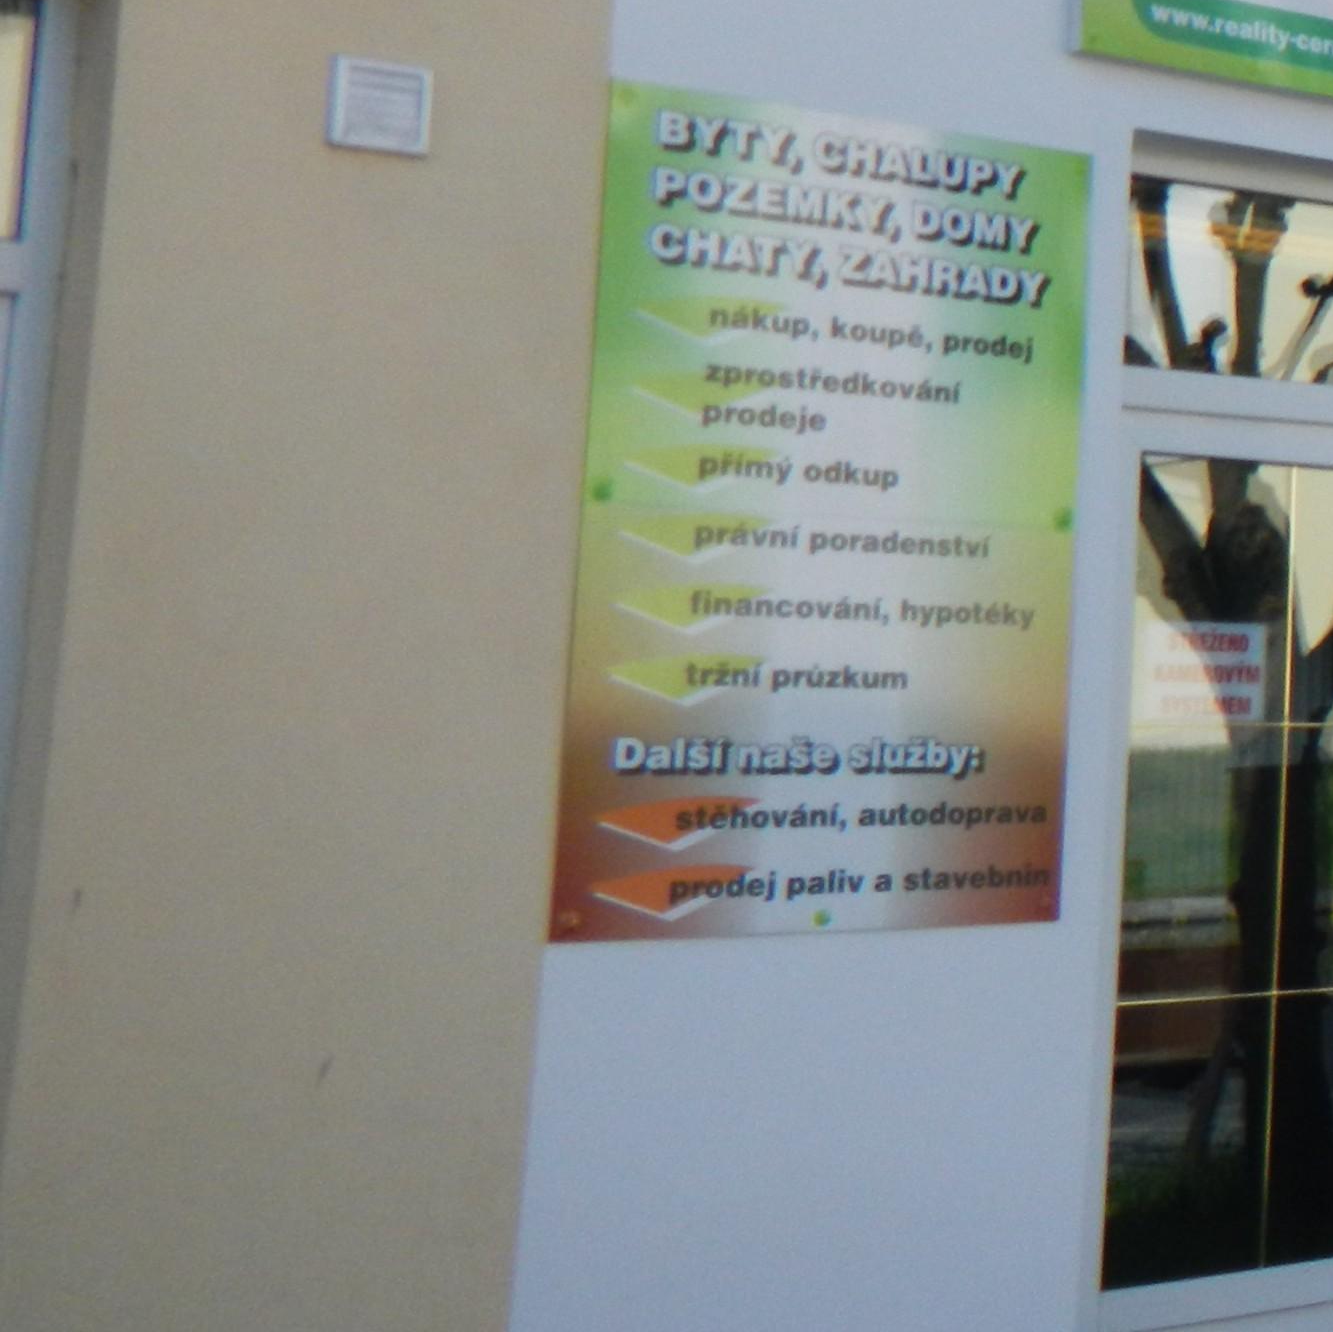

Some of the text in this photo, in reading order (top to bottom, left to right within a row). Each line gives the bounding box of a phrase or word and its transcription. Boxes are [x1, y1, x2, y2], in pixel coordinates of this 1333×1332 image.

[656, 108, 1026, 200] BYTY, CHALUPY
[652, 166, 1040, 255] POZEMKY, DOMY
[650, 223, 1051, 308] CHATY, ZAHRADY
[709, 305, 819, 343] nákup,
[942, 331, 1034, 365] prodej
[705, 362, 961, 404] zprostředkování
[701, 401, 827, 435] prodeje
[698, 454, 900, 493] přímý odkup
[693, 522, 991, 558] právní poradenství
[690, 590, 1036, 632] financování, hypotéky
[686, 660, 760, 688] tržní
[612, 736, 986, 780] Další naše služby:
[675, 801, 1048, 832] stěhování, autodoprava
[668, 864, 1051, 911] prodej paliv a stavebnin
